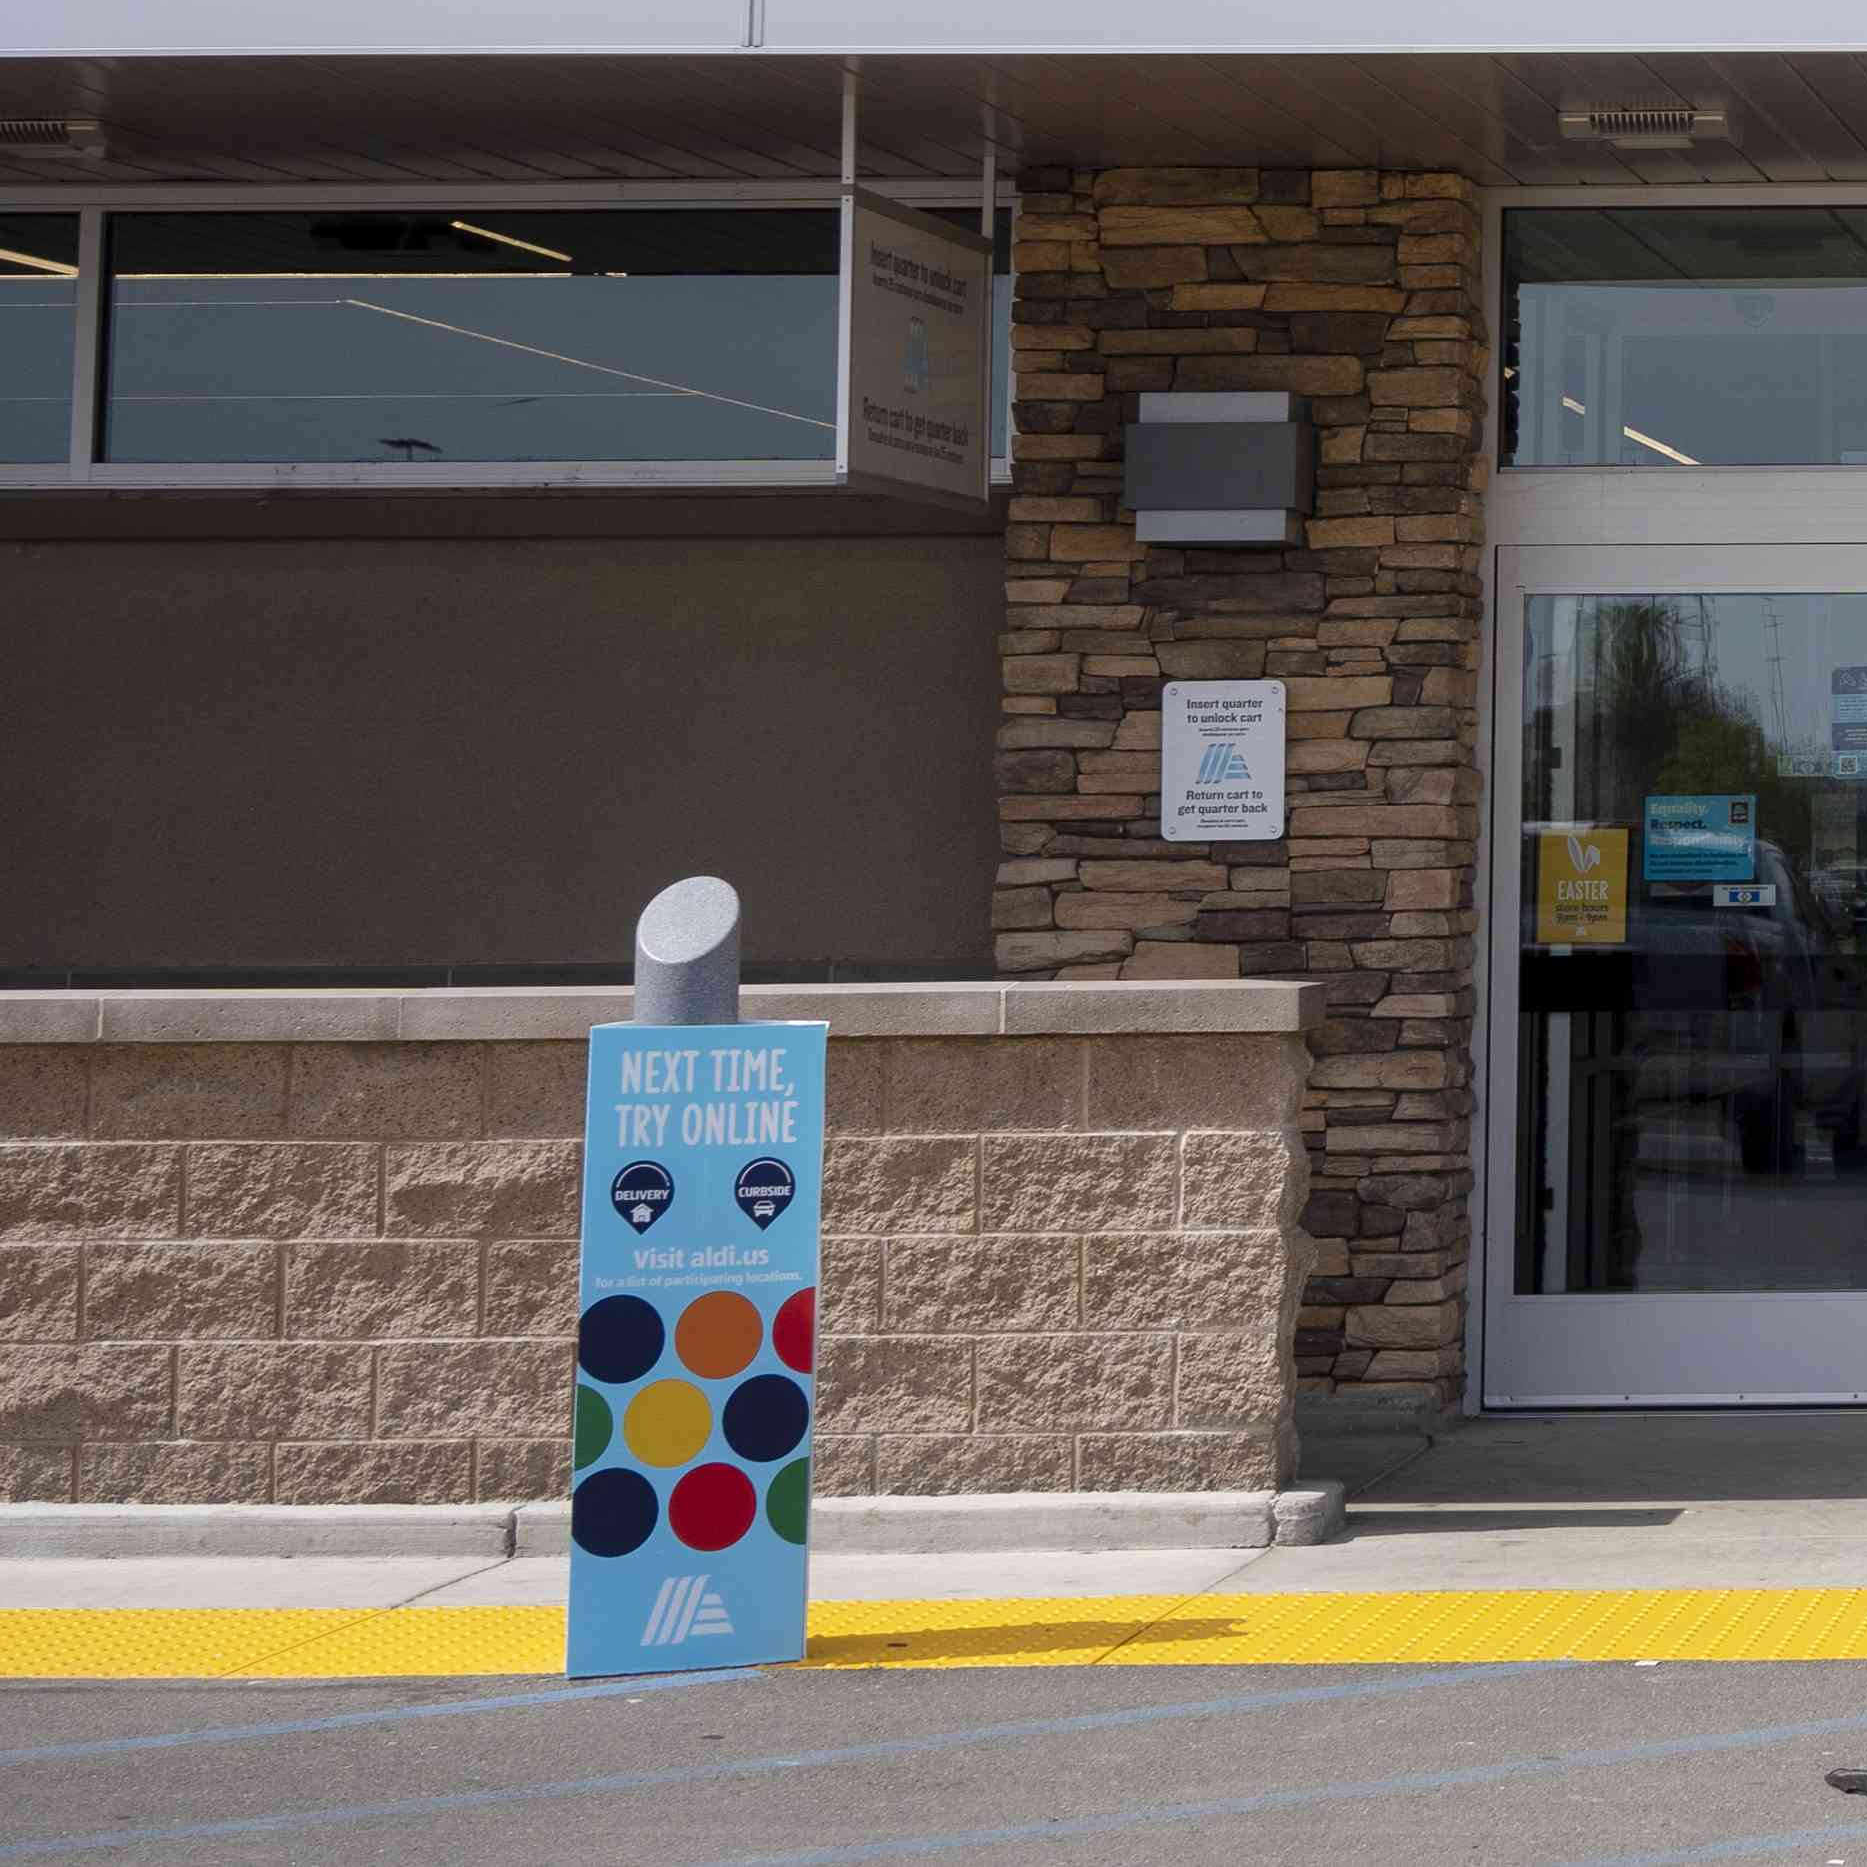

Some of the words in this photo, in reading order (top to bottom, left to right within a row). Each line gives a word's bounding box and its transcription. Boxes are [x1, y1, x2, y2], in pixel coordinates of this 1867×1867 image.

[1186, 699, 1219, 710] Insert
[1222, 699, 1263, 712] quarter
[1187, 713, 1199, 723] to
[1200, 713, 1237, 723] unlock
[1240, 713, 1262, 722] cart
[1186, 790, 1224, 800] Return
[1227, 790, 1249, 800] cart
[1252, 790, 1263, 800] to
[1177, 805, 1196, 816] get
[1199, 804, 1239, 816] quarter
[1241, 803, 1268, 814] back
[1649, 802, 1708, 816] Equality.
[1649, 819, 1708, 831] Respect.
[1557, 880, 1609, 901] EASTER
[1554, 903, 1581, 912] store
[1583, 903, 1609, 912] hours
[620, 1050, 699, 1094] NEXT
[709, 1048, 795, 1096] TIME,
[613, 1103, 671, 1147] TRY
[681, 1100, 801, 1146] ONLINE
[615, 1189, 670, 1201] DELIVERY
[738, 1185, 792, 1198] CURBSIDE
[633, 1247, 684, 1269] Visit
[690, 1245, 769, 1267] aldi.us
[595, 1277, 614, 1288] for
[626, 1276, 646, 1287] list
[649, 1275, 663, 1287] of
[665, 1272, 744, 1288] participating
[746, 1269, 803, 1284] locations.
